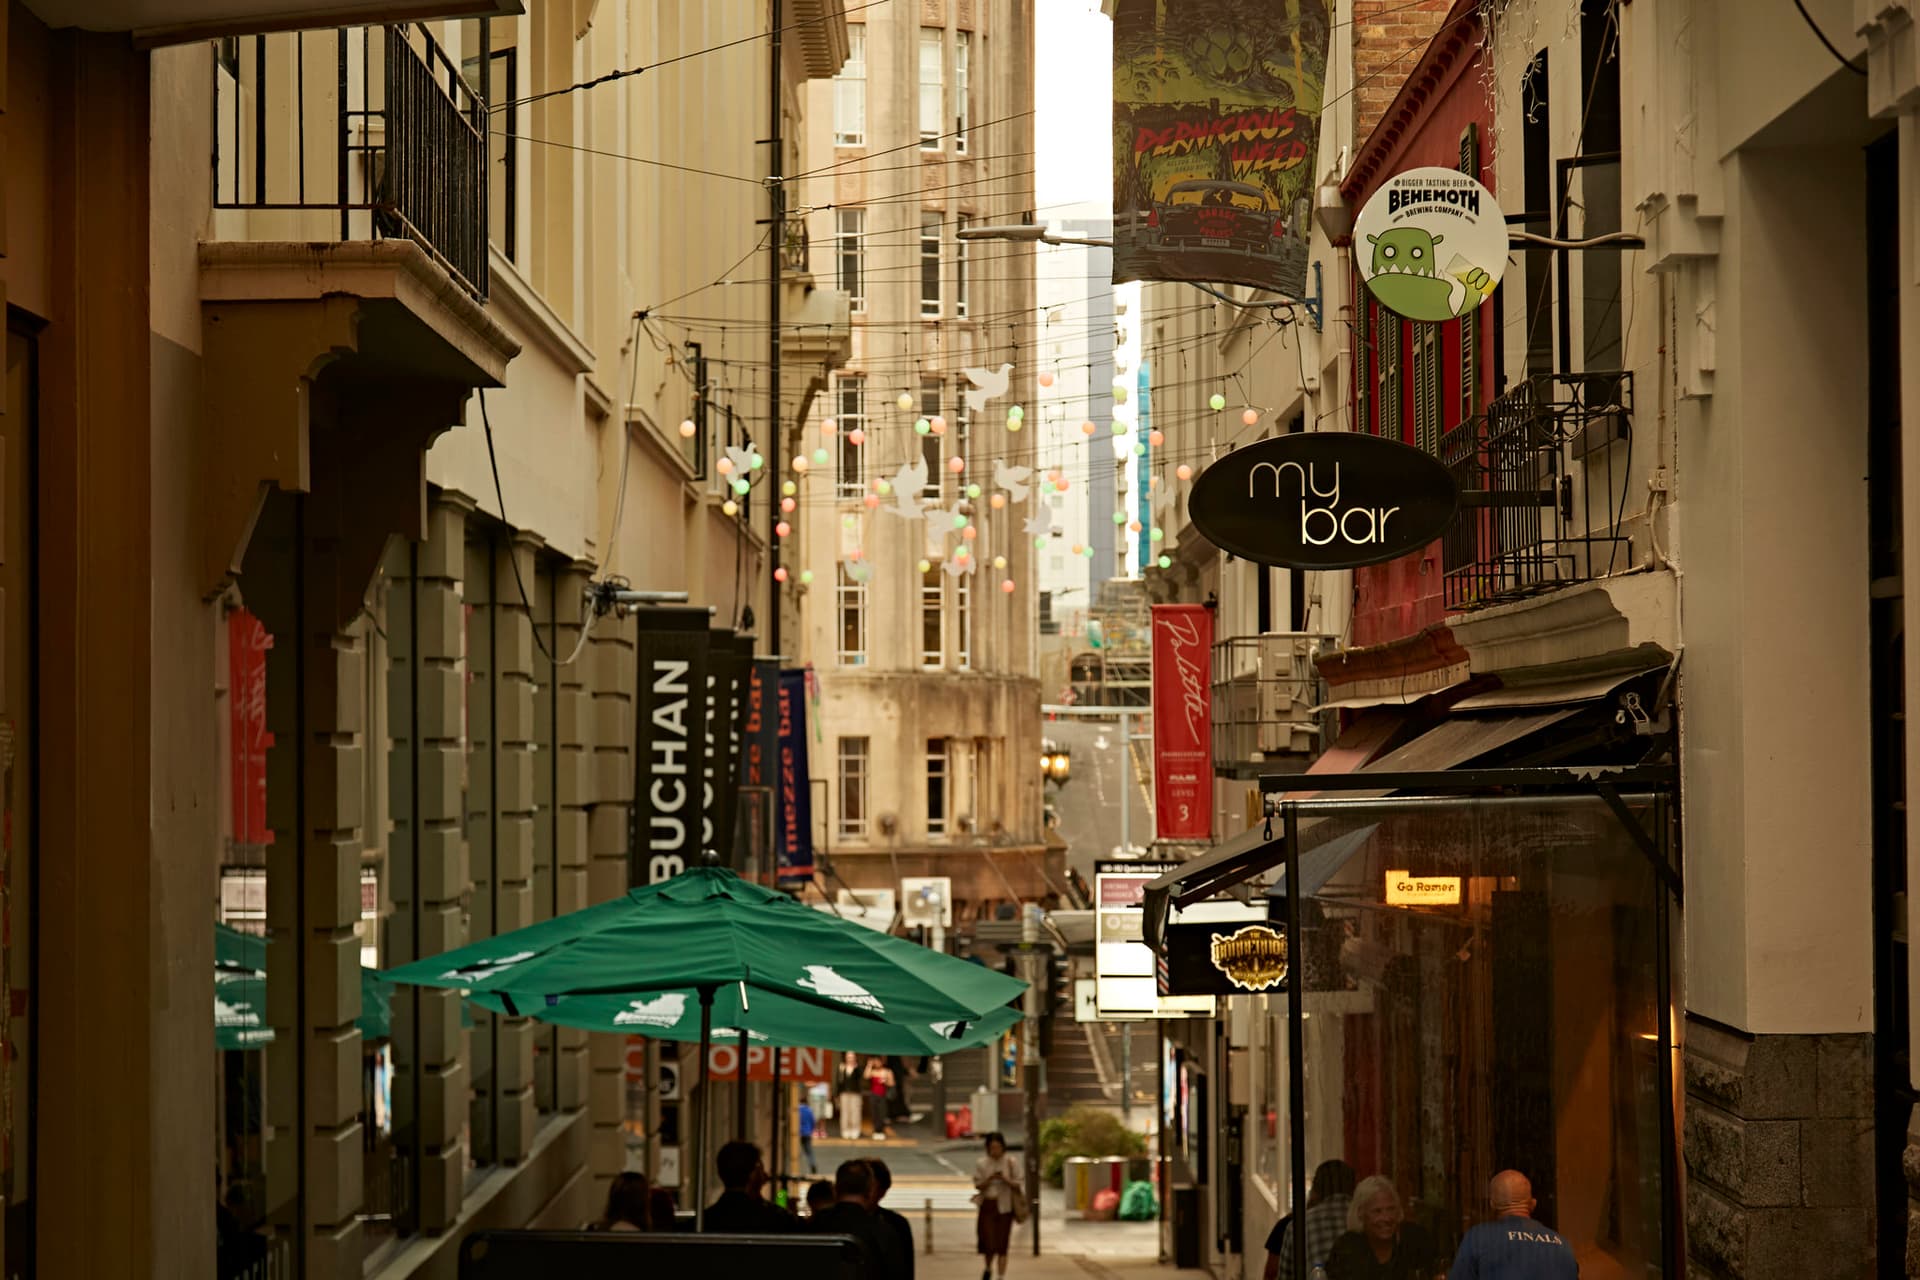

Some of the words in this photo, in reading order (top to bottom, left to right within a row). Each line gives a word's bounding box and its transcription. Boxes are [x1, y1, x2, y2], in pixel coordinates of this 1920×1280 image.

[1135, 106, 1298, 169] PERNICIOUS
[1231, 142, 1308, 178] WEED
[1401, 179, 1424, 187] BIGGER
[1425, 179, 1451, 187] TASTING
[1453, 179, 1468, 187] BEER
[1388, 189, 1480, 216] BEHEMOTH
[1405, 205, 1433, 218] BREWING
[1434, 205, 1464, 218] COMPANY
[1249, 461, 1340, 509] my
[1301, 499, 1400, 545] bar
[746, 667, 763, 734] bar
[778, 683, 792, 737] bar
[649, 660, 689, 885] BUCHAN
[781, 746, 798, 854] mezze
[1178, 803, 1190, 822] 3
[1397, 881, 1413, 892] Go
[1416, 881, 1456, 892] Ramen
[708, 1045, 825, 1076] OPEN
[1507, 1231, 1563, 1246] FINALS
